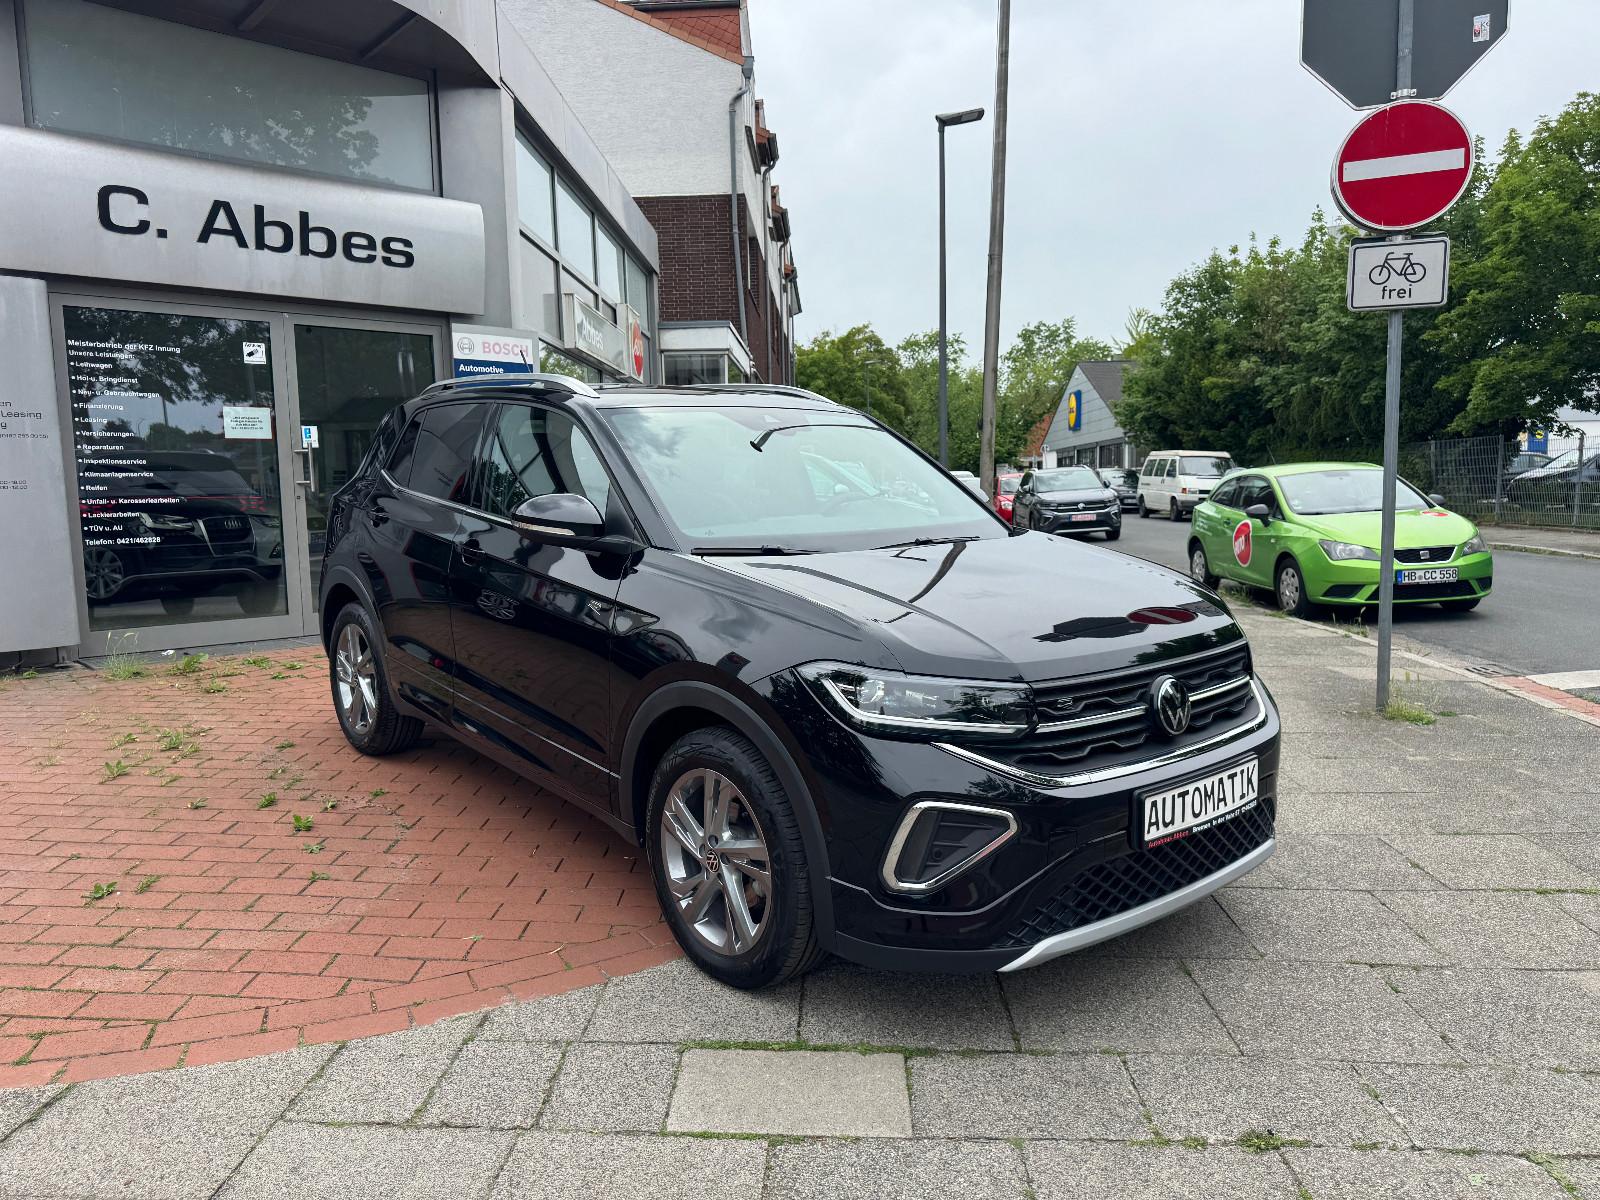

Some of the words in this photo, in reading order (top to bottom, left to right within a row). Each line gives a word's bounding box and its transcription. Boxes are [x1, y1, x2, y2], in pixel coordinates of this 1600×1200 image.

[97, 184, 168, 239] C.
[196, 199, 415, 268] Abbes
[1381, 283, 1413, 300] frei
[67, 339, 123, 349] Meisterbetrieb
[124, 342, 137, 350] der
[138, 343, 154, 351] KFZ
[155, 344, 181, 354] Innung
[482, 341, 529, 358] BOSCH
[68, 349, 95, 357] Unsere
[95, 350, 136, 360] Leistungen:
[75, 360, 113, 370] Leihwagen
[459, 363, 504, 374] Automotive
[98, 375, 139, 384] Bringdienst
[103, 389, 160, 399] Gebrauchtwagen
[79, 402, 124, 411] Finanzierung
[80, 416, 108, 424] Leasing
[81, 430, 135, 438] Versicherungen
[82, 443, 124, 451] Reparaturen
[83, 457, 147, 465] Inspektionsservice
[84, 471, 154, 479] Klimaanlagenservice
[118, 497, 180, 505] Karosseriearbeiten
[88, 511, 140, 519] Lackierarbeiten
[88, 524, 104, 532] TÜV
[84, 538, 115, 546] Telefon:
[1403, 571, 1417, 582] HB
[1423, 570, 1437, 581] CC
[1439, 568, 1457, 580] 558
[1146, 763, 1256, 834] AUTOMATIK
